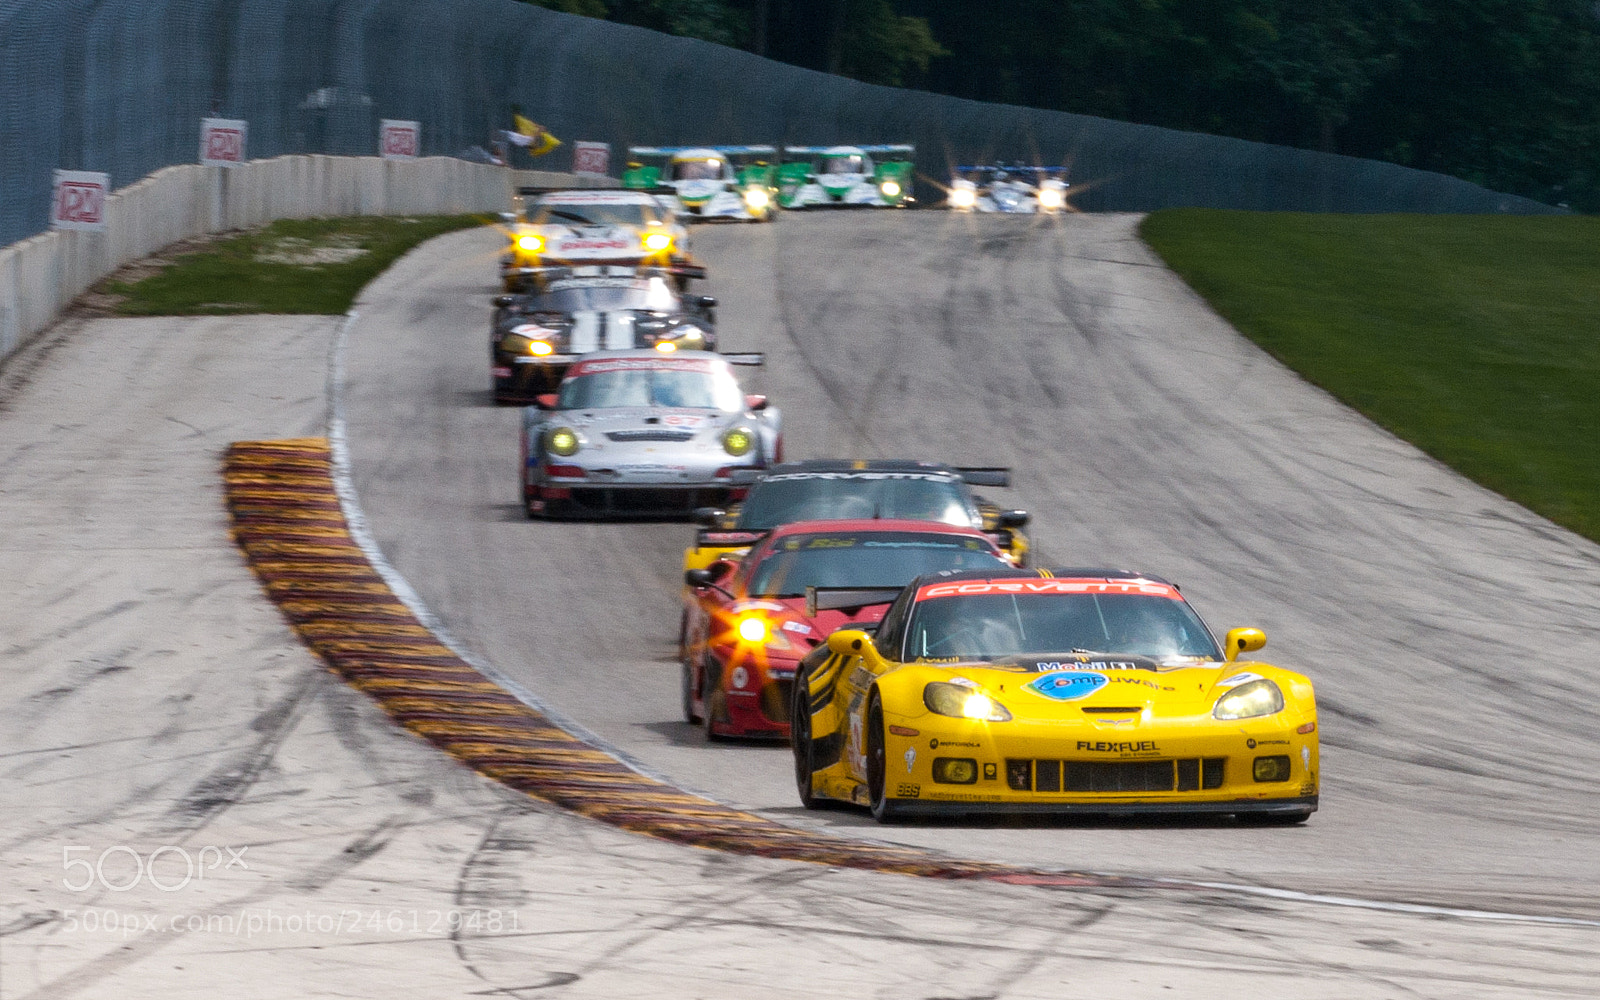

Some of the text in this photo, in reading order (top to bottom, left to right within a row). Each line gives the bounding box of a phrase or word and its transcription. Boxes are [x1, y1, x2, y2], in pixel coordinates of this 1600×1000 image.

[926, 581, 1168, 597] CORVETTE
[1037, 661, 1107, 672] Mobil
[1038, 676, 1176, 692] Compuware
[1076, 741, 1161, 752] FLEXFUEL
[897, 782, 920, 797] BBS
